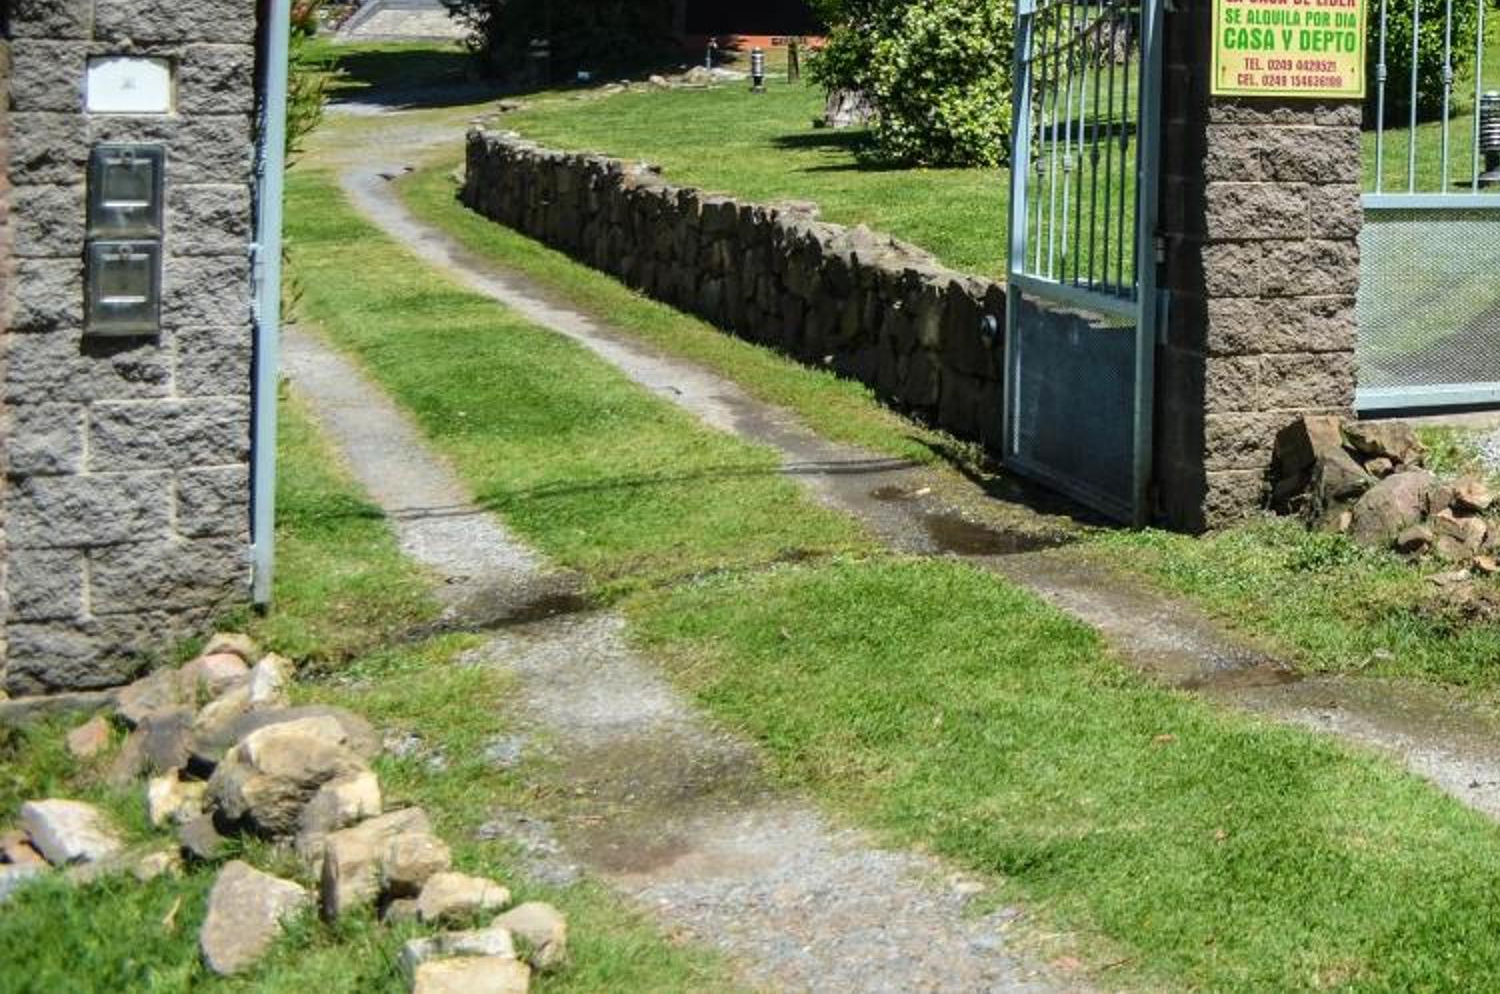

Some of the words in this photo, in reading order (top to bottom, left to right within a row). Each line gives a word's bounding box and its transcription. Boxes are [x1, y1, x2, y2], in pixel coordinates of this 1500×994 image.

[1225, 8, 1241, 24] SE
[1247, 9, 1301, 26] ALQUILA
[1305, 11, 1330, 27] POR
[1335, 12, 1357, 28] DIA
[1223, 28, 1275, 50] CASA
[1281, 29, 1293, 50] Y
[1299, 30, 1357, 52] DEPTO
[1244, 58, 1264, 71] TEL.
